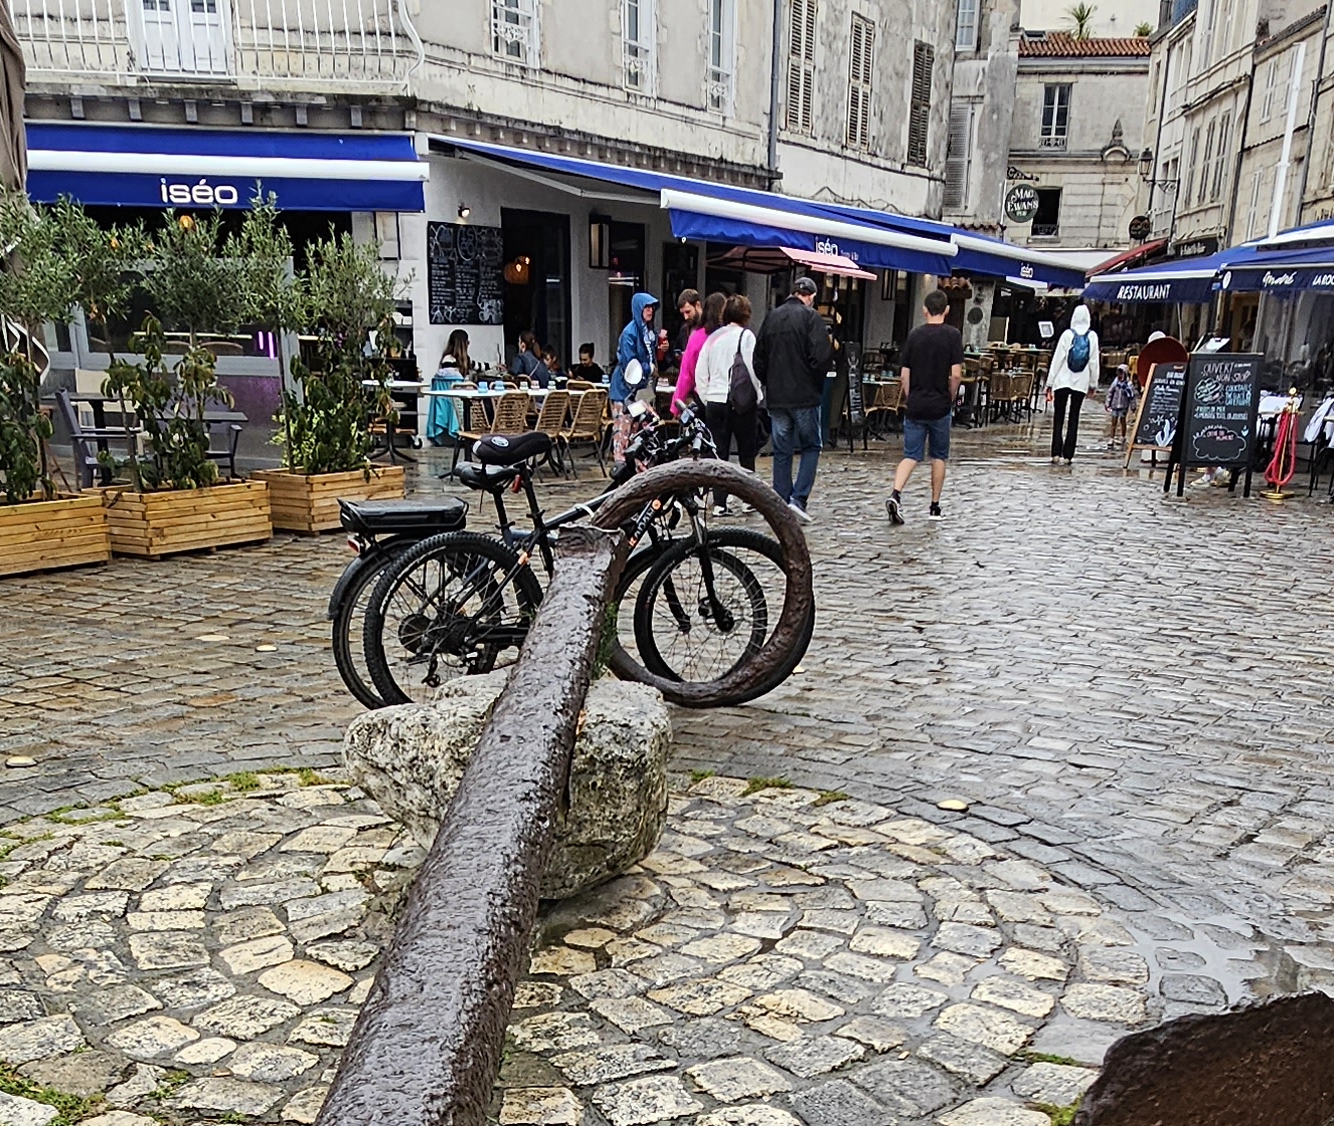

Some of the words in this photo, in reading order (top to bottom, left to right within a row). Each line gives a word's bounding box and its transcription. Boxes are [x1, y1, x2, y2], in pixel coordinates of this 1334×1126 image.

[160, 177, 238, 204] iséo
[1015, 188, 1034, 199] MAC
[1312, 274, 1323, 286] LA
[1117, 284, 1171, 300] RESTAURANT
